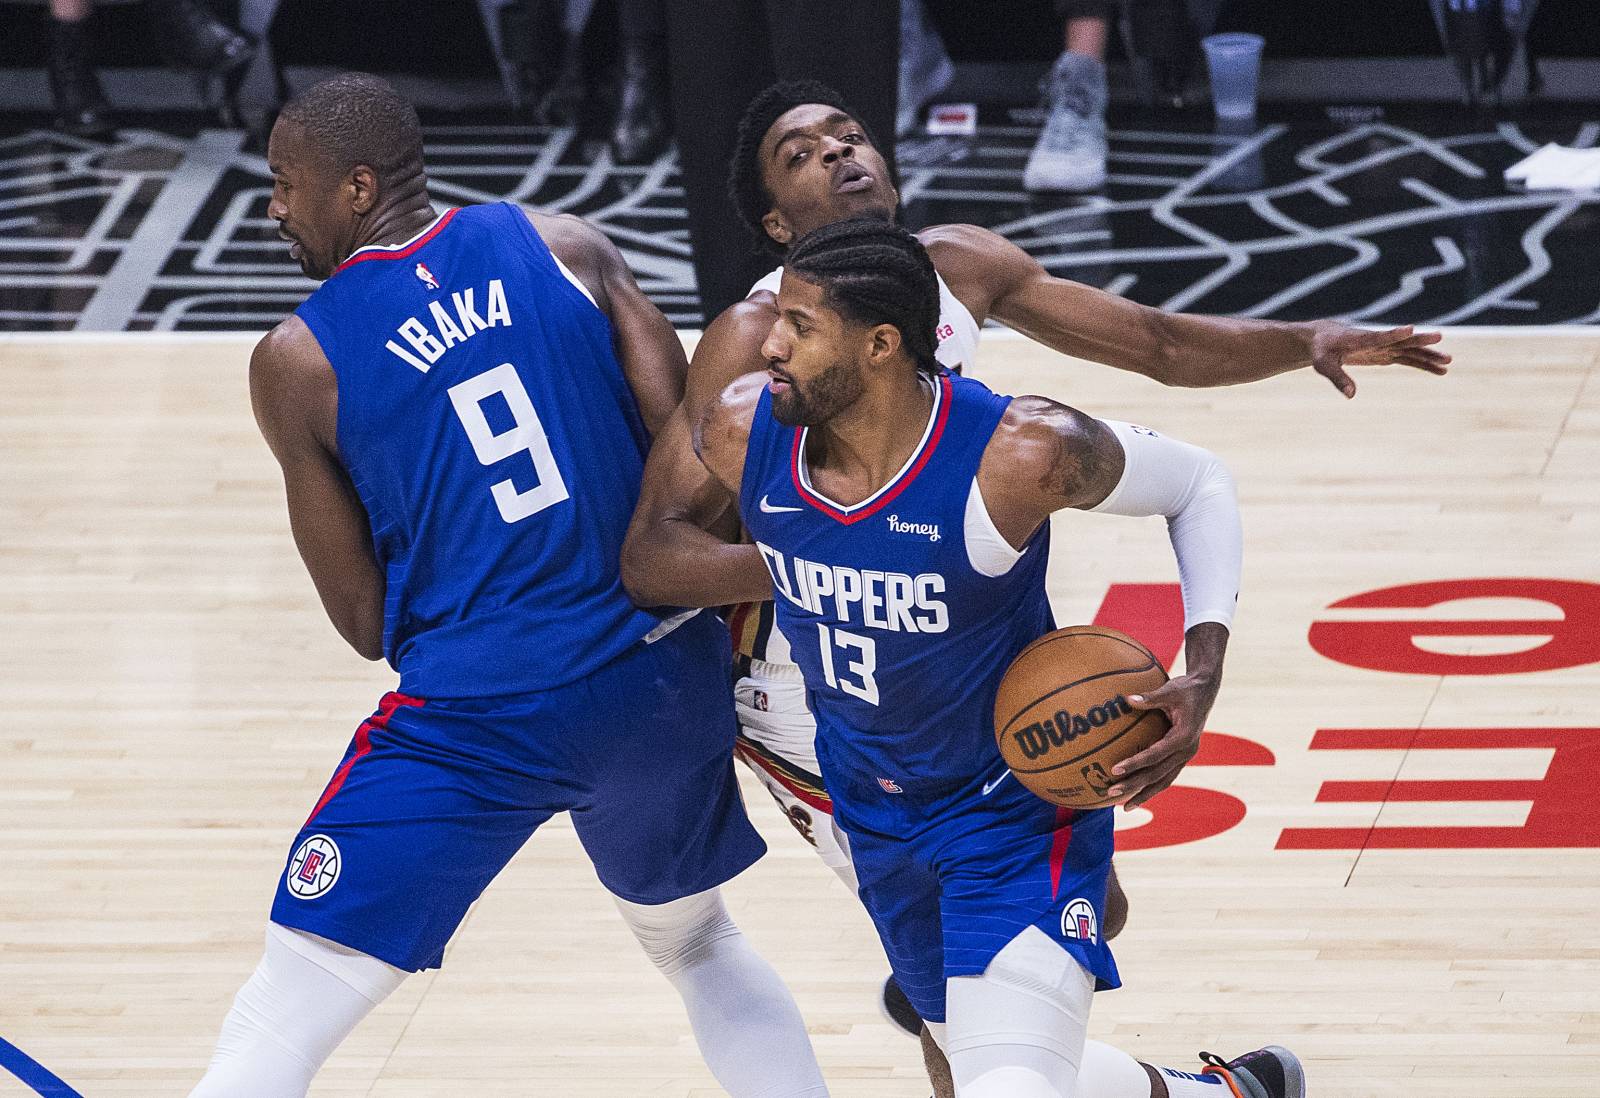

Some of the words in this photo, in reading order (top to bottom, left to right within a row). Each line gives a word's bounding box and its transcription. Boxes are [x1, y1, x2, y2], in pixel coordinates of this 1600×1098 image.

[385, 279, 512, 374] IBAKA
[447, 362, 570, 524] 9
[886, 514, 942, 542] honey
[756, 541, 950, 634] CLIPPERS
[816, 622, 880, 707] 13
[1012, 693, 1133, 760] Wilson
